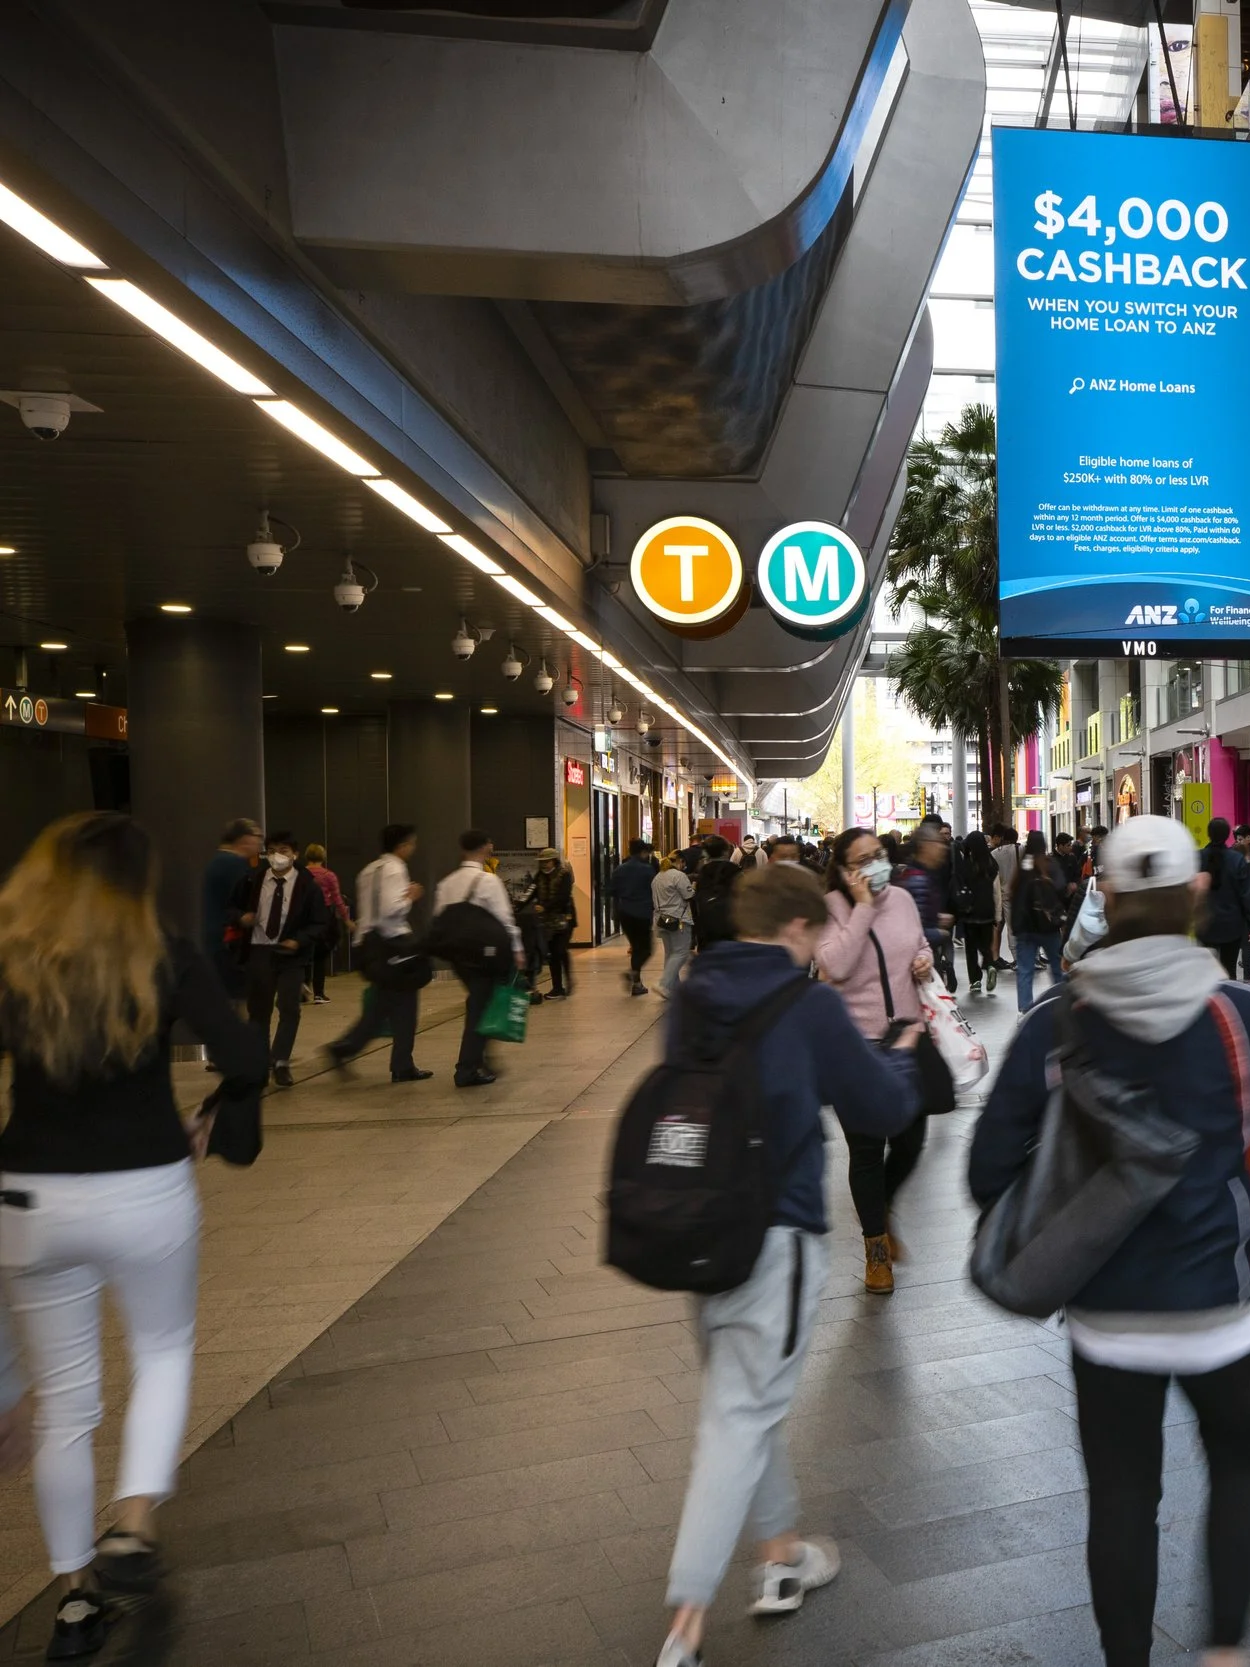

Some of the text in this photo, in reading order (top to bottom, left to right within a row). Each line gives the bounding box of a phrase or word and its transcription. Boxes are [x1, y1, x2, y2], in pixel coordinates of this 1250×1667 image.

[1033, 189, 1229, 246] $4,000
[1016, 248, 1248, 290] CASHBACK
[1027, 297, 1238, 319] WHEN YOU SWITCH YOUR
[1051, 316, 1216, 336] HOME LOAN TO ANZ
[1089, 379, 1196, 394] ANZ Home Loans
[1079, 455, 1193, 469] Eligible home loans of
[1063, 472, 1209, 486] $250K+ with 80% or less LVR
[1038, 503, 1056, 511] Offer
[1082, 504, 1119, 512] withdrawn
[1129, 506, 1141, 514] any
[1033, 513, 1056, 521] within
[1080, 514, 1104, 522] month
[1105, 515, 1129, 523] period.
[1130, 515, 1148, 523] Offer
[1156, 515, 1180, 523] $4,000
[1180, 516, 1211, 524] cashback
[1212, 516, 1222, 524] for
[1031, 523, 1045, 531] LVR
[1071, 524, 1094, 532] $2,000
[1139, 525, 1152, 533] LVR
[1153, 525, 1174, 533] above
[1209, 526, 1231, 534] within
[1029, 533, 1046, 542] days
[1066, 534, 1092, 543] eligible
[1093, 534, 1108, 542] ANZ
[1139, 535, 1157, 543] Offer
[1179, 536, 1241, 544] anz.com/cashback.
[1074, 544, 1200, 554] Fees, charges, eligibility criteria apply.
[663, 544, 710, 602] T
[783, 545, 840, 602] M
[1124, 605, 1178, 625] ANZ
[1210, 605, 1224, 614] For
[1122, 641, 1157, 656] VMO
